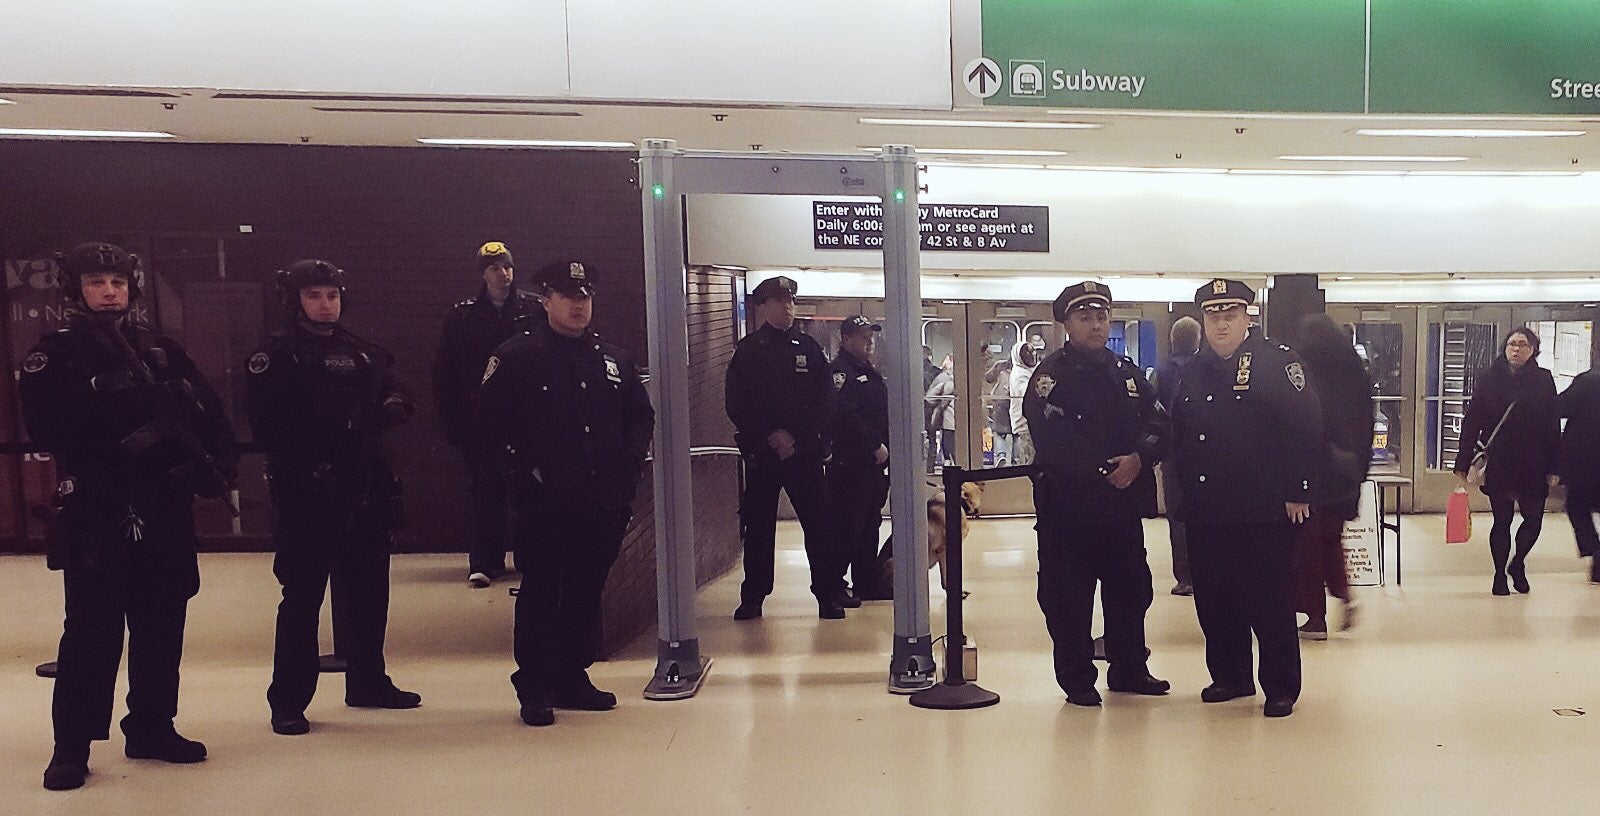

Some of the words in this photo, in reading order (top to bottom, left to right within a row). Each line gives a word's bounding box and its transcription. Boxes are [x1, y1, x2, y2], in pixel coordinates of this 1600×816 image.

[1052, 69, 1146, 97] Subway
[816, 204, 850, 216] Enter
[853, 204, 883, 217] with
[933, 207, 999, 219] MetroCard
[817, 219, 848, 233] Daily
[937, 223, 951, 232] or
[955, 224, 977, 233] see
[981, 223, 1017, 236] agent
[1020, 223, 1034, 234] at
[818, 233, 839, 245] the
[843, 234, 860, 245] NE
[927, 236, 942, 247] 42
[945, 236, 958, 247] St
[963, 236, 973, 247] &
[977, 236, 985, 248] 8
[989, 237, 1007, 248] Av
[325, 359, 356, 367] POLICE
